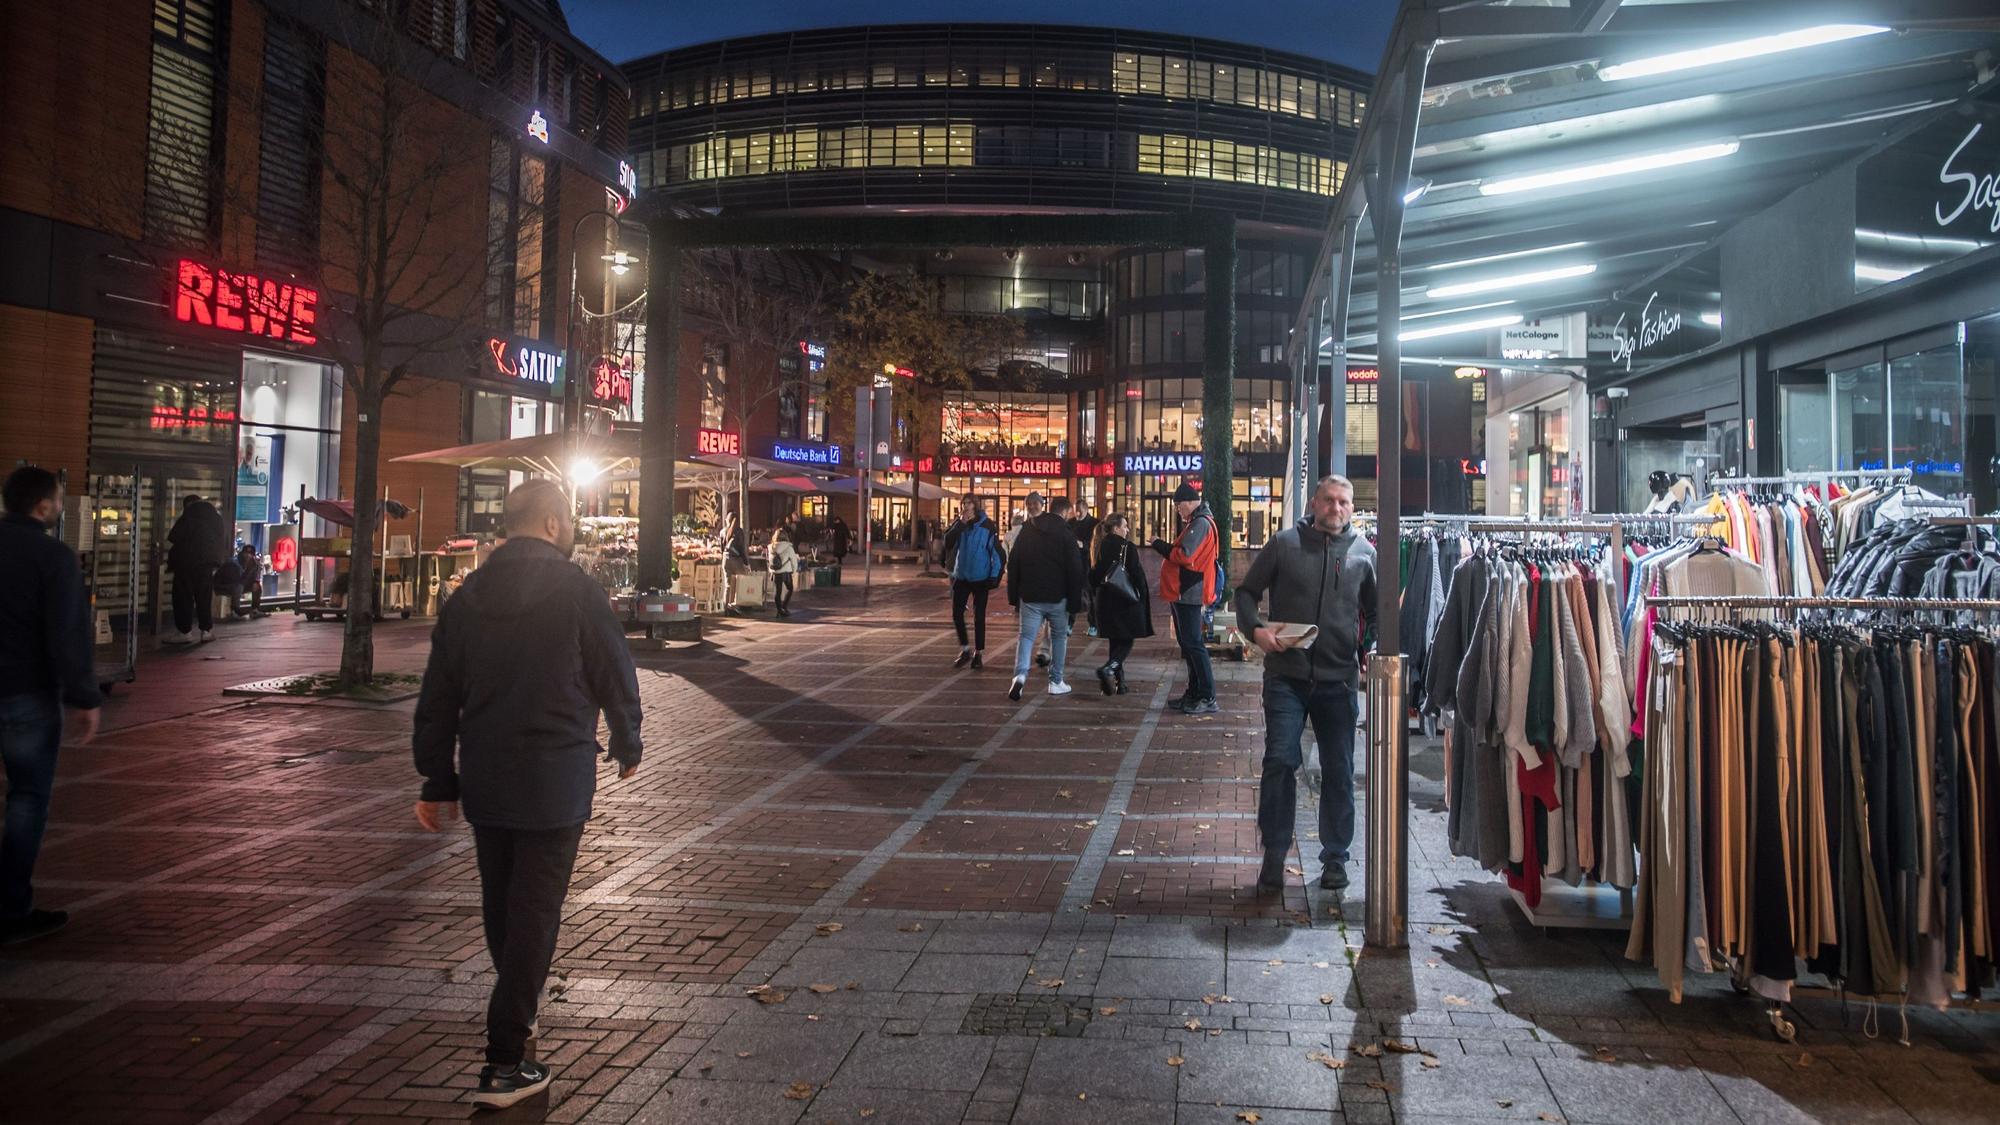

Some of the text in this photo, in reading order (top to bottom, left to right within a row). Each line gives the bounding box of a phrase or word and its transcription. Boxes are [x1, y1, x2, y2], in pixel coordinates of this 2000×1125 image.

[1934, 122, 2000, 233] Sag
[176, 259, 318, 345] REWE
[1505, 330, 1560, 342] NetCologne
[1611, 290, 1682, 372] Sagi Fashion
[519, 347, 562, 384] SATU
[1347, 369, 1379, 380] vodafo
[699, 431, 739, 455] REWE
[774, 446, 828, 463] Deutsche Bank
[1124, 454, 1203, 472] RATHAUS
